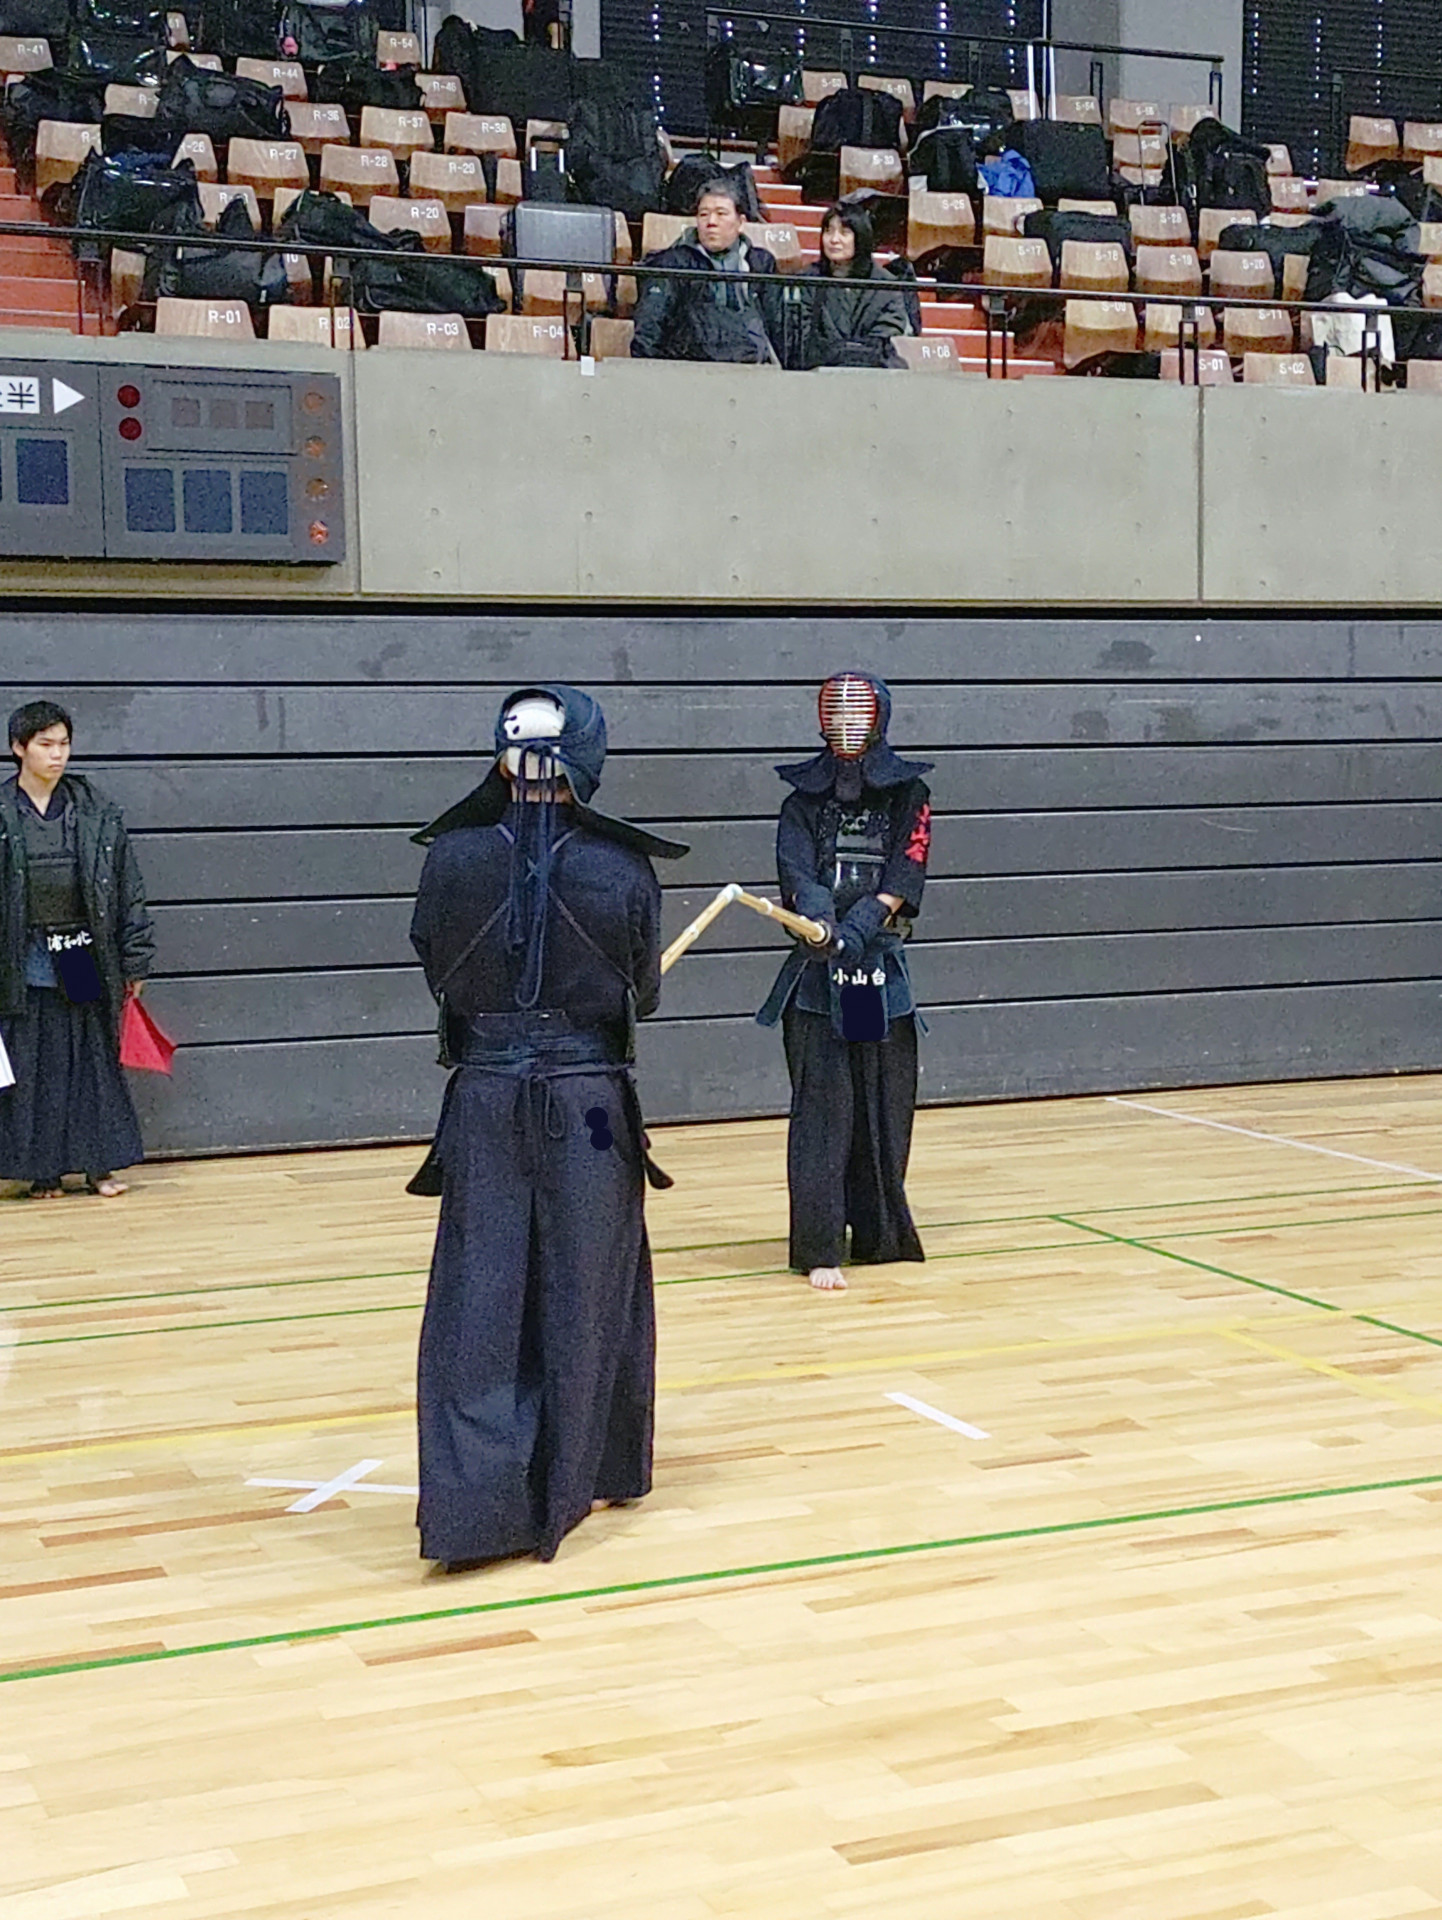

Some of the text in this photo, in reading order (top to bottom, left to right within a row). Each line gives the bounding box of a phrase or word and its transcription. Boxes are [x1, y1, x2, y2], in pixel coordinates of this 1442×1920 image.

[390, 38, 413, 48] R-54
[273, 68, 299, 79] R-44
[398, 116, 424, 129] R-37
[361, 155, 389, 168] R-28
[411, 207, 440, 219] R-20
[765, 230, 791, 242] R-24
[208, 310, 241, 324] R-01
[319, 317, 351, 331] R02
[427, 322, 459, 337] R-03
[532, 326, 564, 340] R-04
[922, 346, 952, 360] R-08
[1198, 358, 1224, 371] S-01
[1279, 363, 1305, 375] S-02
[0, 382, 36, 410] 半
[832, 967, 886, 986] 小山台
